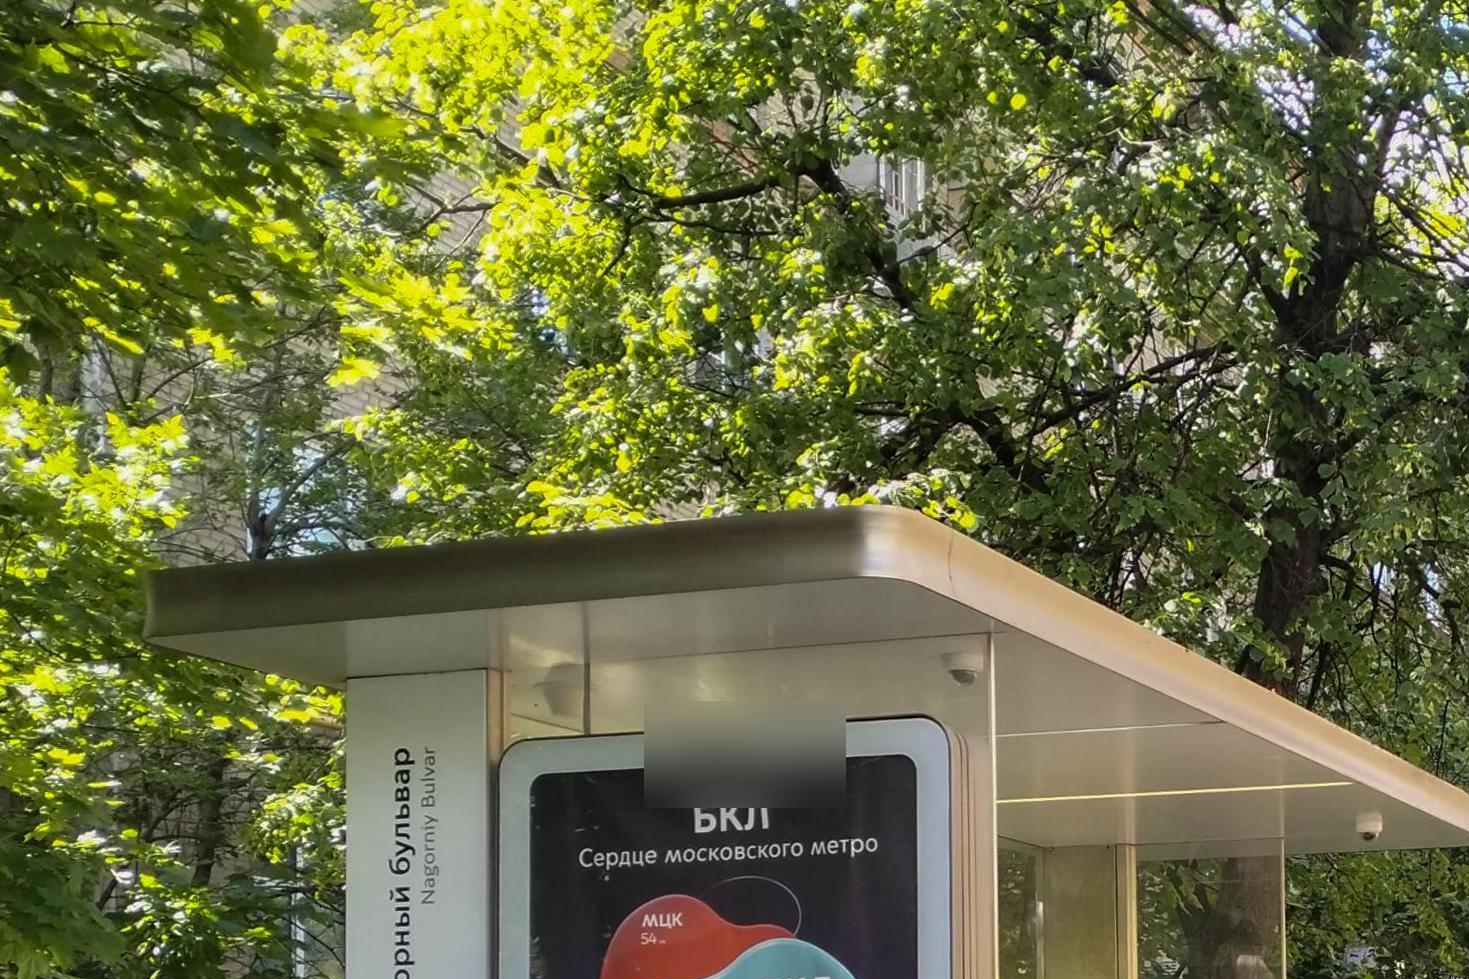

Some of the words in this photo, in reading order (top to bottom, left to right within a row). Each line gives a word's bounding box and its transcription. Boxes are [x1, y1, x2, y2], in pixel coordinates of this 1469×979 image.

[420, 747, 436, 808] Bulvar
[388, 748, 416, 875] бульвар
[420, 815, 440, 905] Nagorniy
[578, 847, 658, 870] Сердце
[664, 841, 804, 864] московского
[810, 837, 879, 858] метро
[640, 932, 657, 945] 54
[641, 912, 683, 928] МЦК
